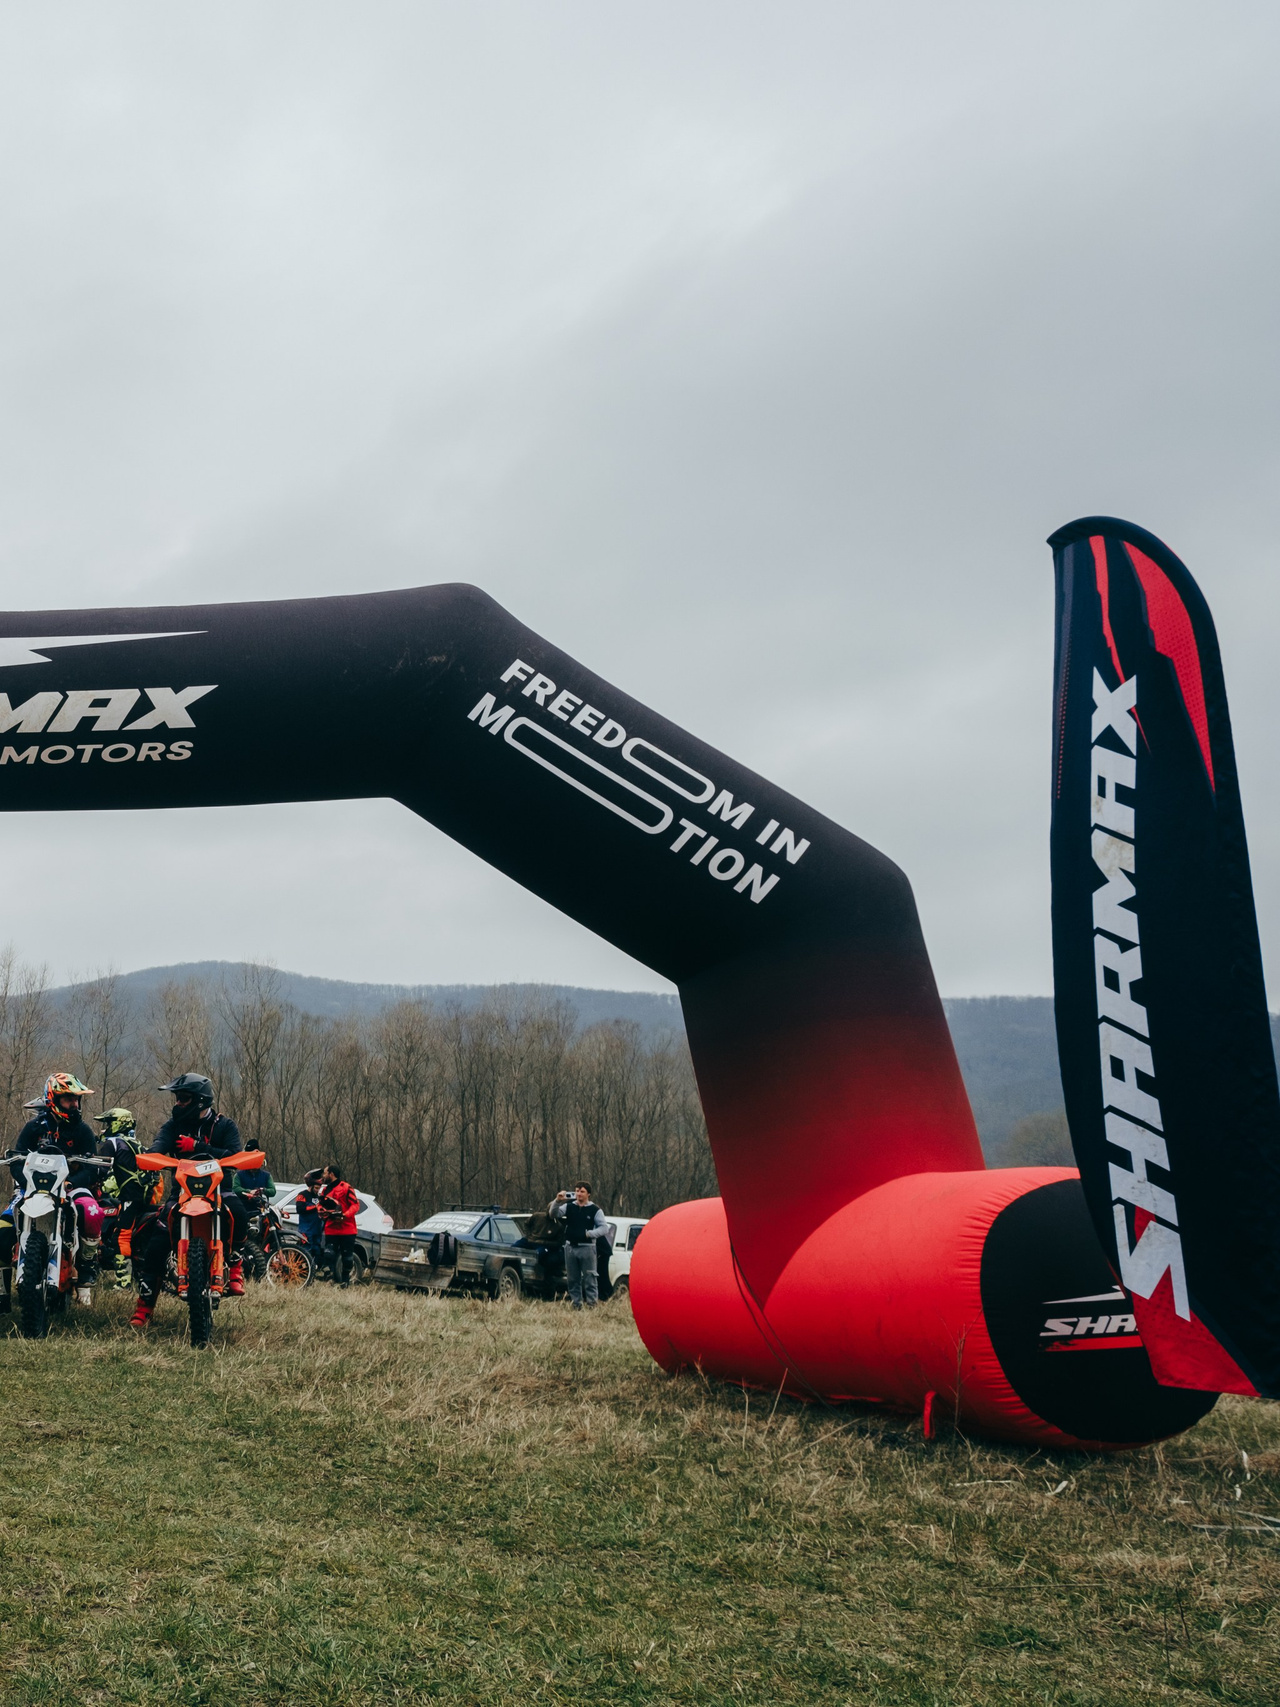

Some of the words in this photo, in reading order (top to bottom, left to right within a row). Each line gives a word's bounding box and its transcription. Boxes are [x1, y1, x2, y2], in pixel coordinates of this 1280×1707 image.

[467, 692, 780, 904] MOTION
[500, 658, 755, 830] FREEDOM
[755, 818, 811, 865] IN
[1090, 666, 1190, 1322] SHARMAX
[1039, 1313, 1139, 1337] SHA
